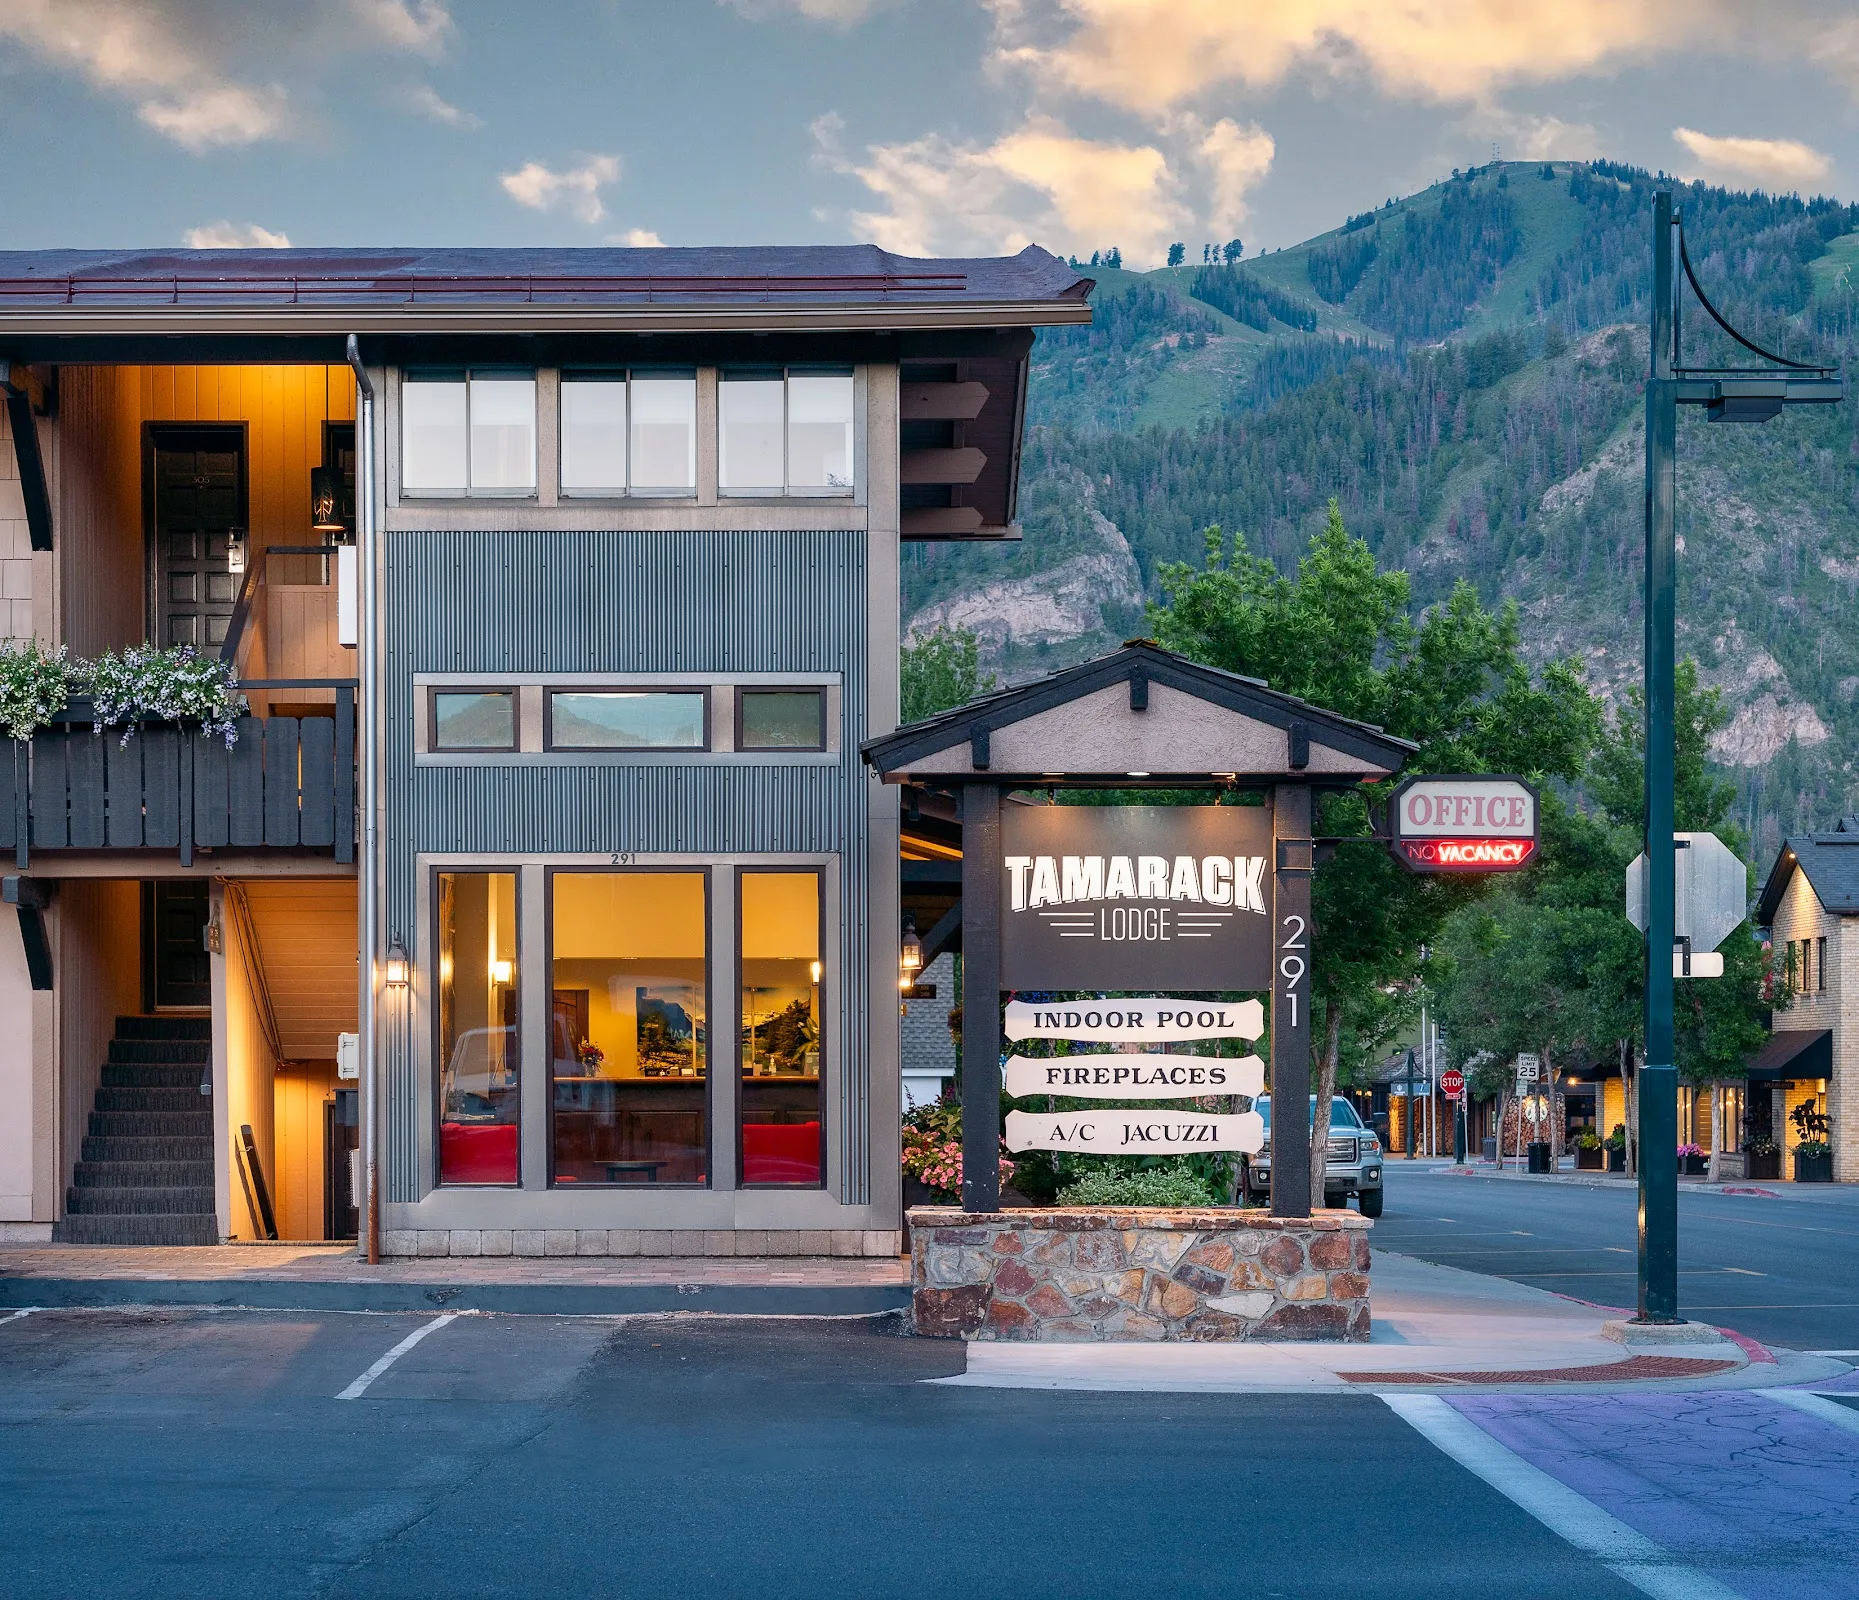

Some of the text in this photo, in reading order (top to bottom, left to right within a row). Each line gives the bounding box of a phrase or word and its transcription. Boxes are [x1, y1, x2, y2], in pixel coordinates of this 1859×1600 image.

[1407, 794, 1526, 828] OFFICE
[611, 853, 636, 865] 291
[1408, 843, 1523, 862] NO VACANCY
[1004, 855, 1268, 916] TAMARACK
[1101, 907, 1171, 941] LODGE
[1279, 915, 1306, 1027] 291
[1033, 1011, 1235, 1028] INDOOR POOL
[1046, 1067, 1226, 1085] FIREPLACES
[1519, 1066, 1537, 1077] 25
[1442, 1077, 1464, 1087] STOP
[1049, 1122, 1219, 1145] A/C JACUZZI
